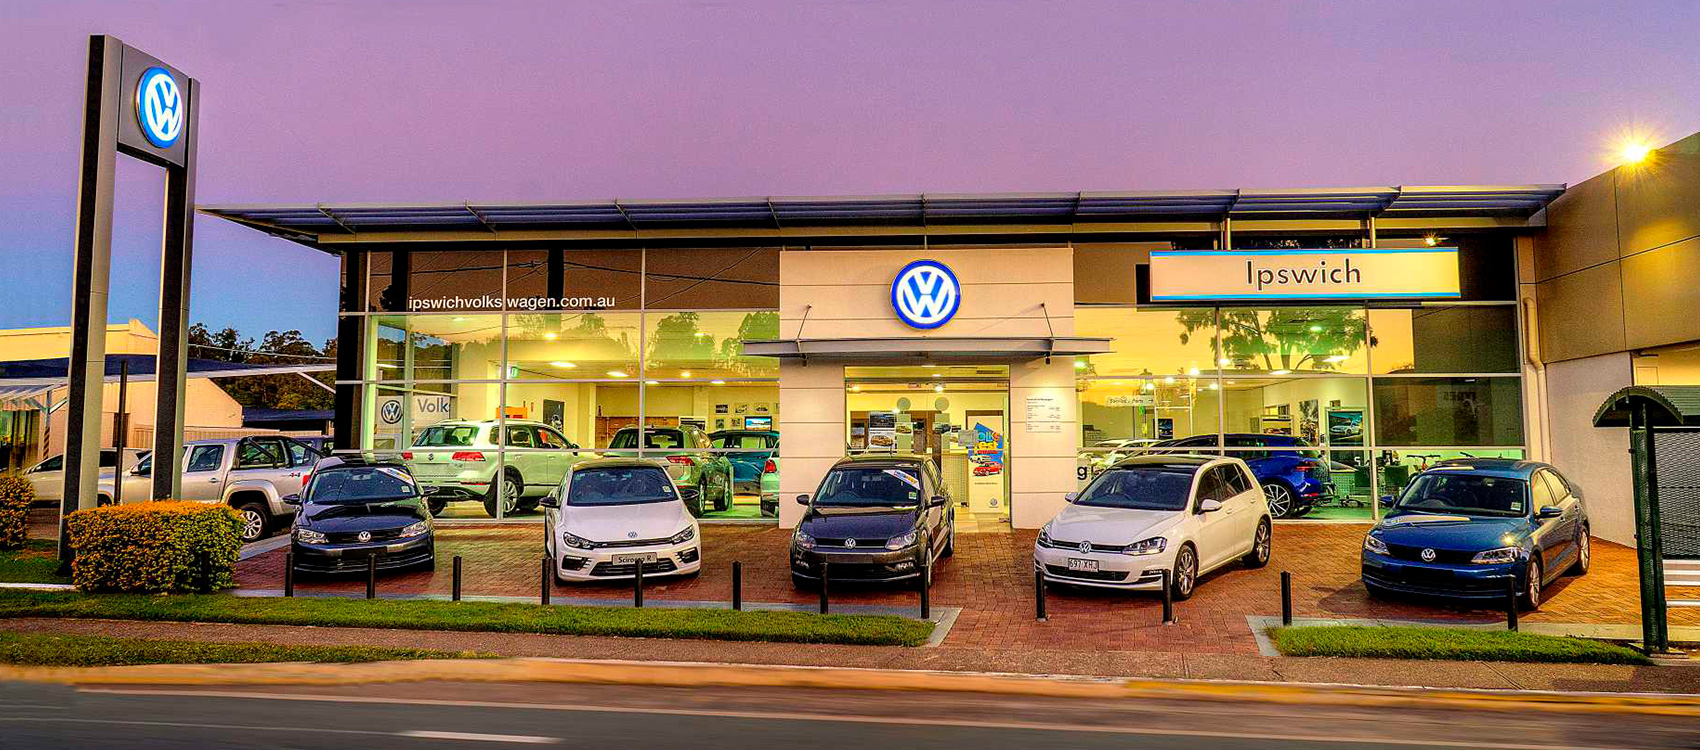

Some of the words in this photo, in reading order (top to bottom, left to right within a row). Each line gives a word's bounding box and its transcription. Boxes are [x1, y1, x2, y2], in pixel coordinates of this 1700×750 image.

[1246, 258, 1361, 291] Ipswich
[895, 264, 957, 325] VW
[417, 397, 450, 413] Volk
